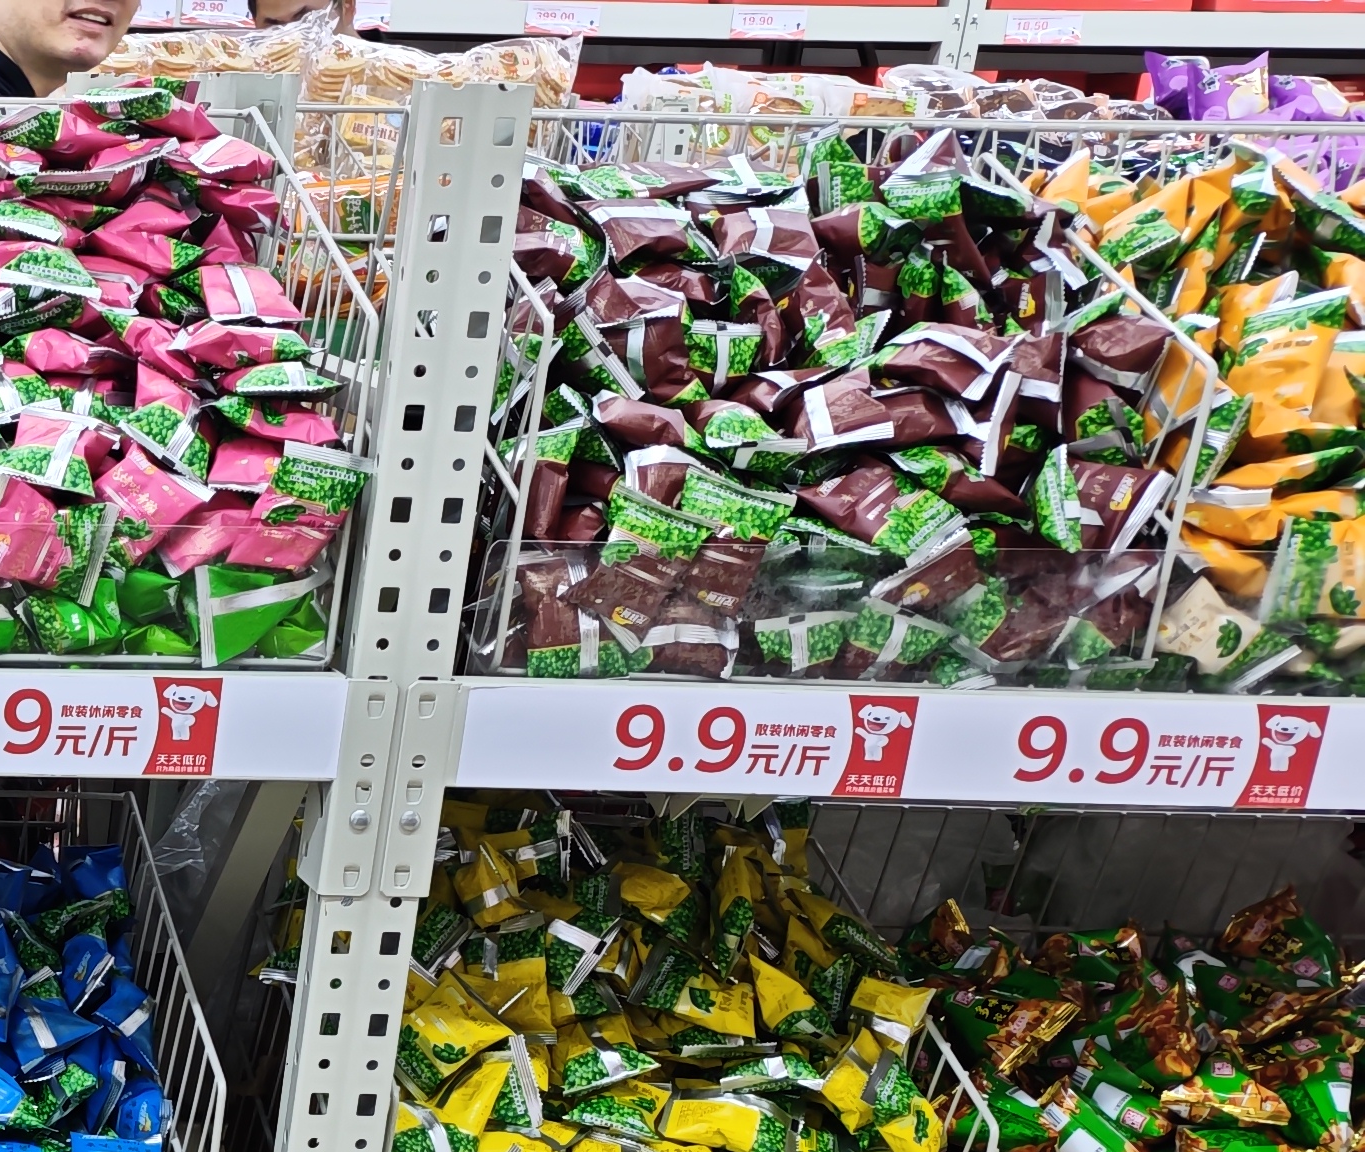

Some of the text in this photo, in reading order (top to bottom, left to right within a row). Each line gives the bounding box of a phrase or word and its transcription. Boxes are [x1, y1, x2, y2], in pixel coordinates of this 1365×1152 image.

[191, 1, 224, 12] 29.90
[742, 15, 774, 26] 19.90
[60, 704, 144, 719] 散装休闲零食
[754, 723, 838, 739] 散装休闲零食
[54, 725, 137, 758] 元/斤
[615, 705, 746, 773] 9.9
[1157, 734, 1244, 749] 散装休闲零食
[1015, 716, 1149, 784] 9.9
[155, 754, 208, 765] 天天低价
[745, 744, 830, 777] 元/斤
[1146, 755, 1234, 788] 元/斤
[845, 774, 898, 786] 天天低价
[1248, 785, 1304, 796] 天天低价
